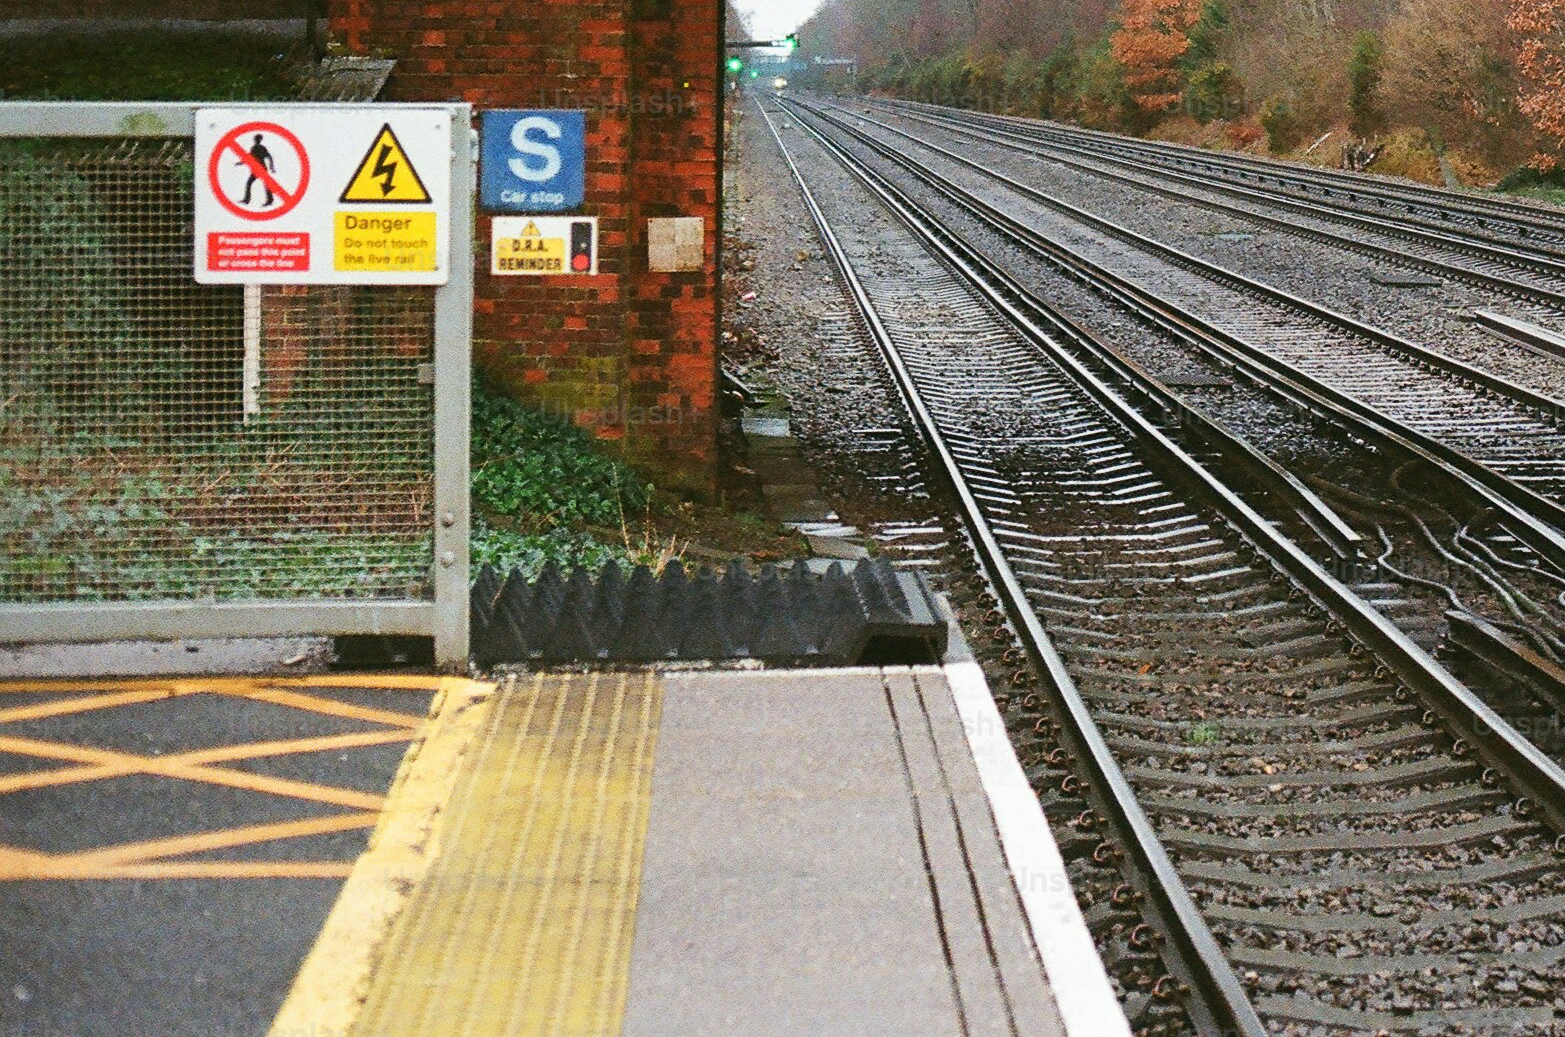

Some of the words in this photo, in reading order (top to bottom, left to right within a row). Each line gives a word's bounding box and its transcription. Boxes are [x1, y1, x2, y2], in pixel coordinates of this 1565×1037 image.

[508, 116, 562, 182] S
[500, 190, 527, 203] Car
[530, 191, 564, 205] stop
[345, 215, 411, 233] Danger
[344, 238, 362, 248] Do
[366, 239, 387, 248] not
[391, 238, 428, 248] touch
[512, 239, 548, 252] D.R.A.
[344, 254, 365, 263] the
[368, 254, 390, 263] live
[394, 254, 415, 263] rail
[499, 257, 562, 271] REMINDER
